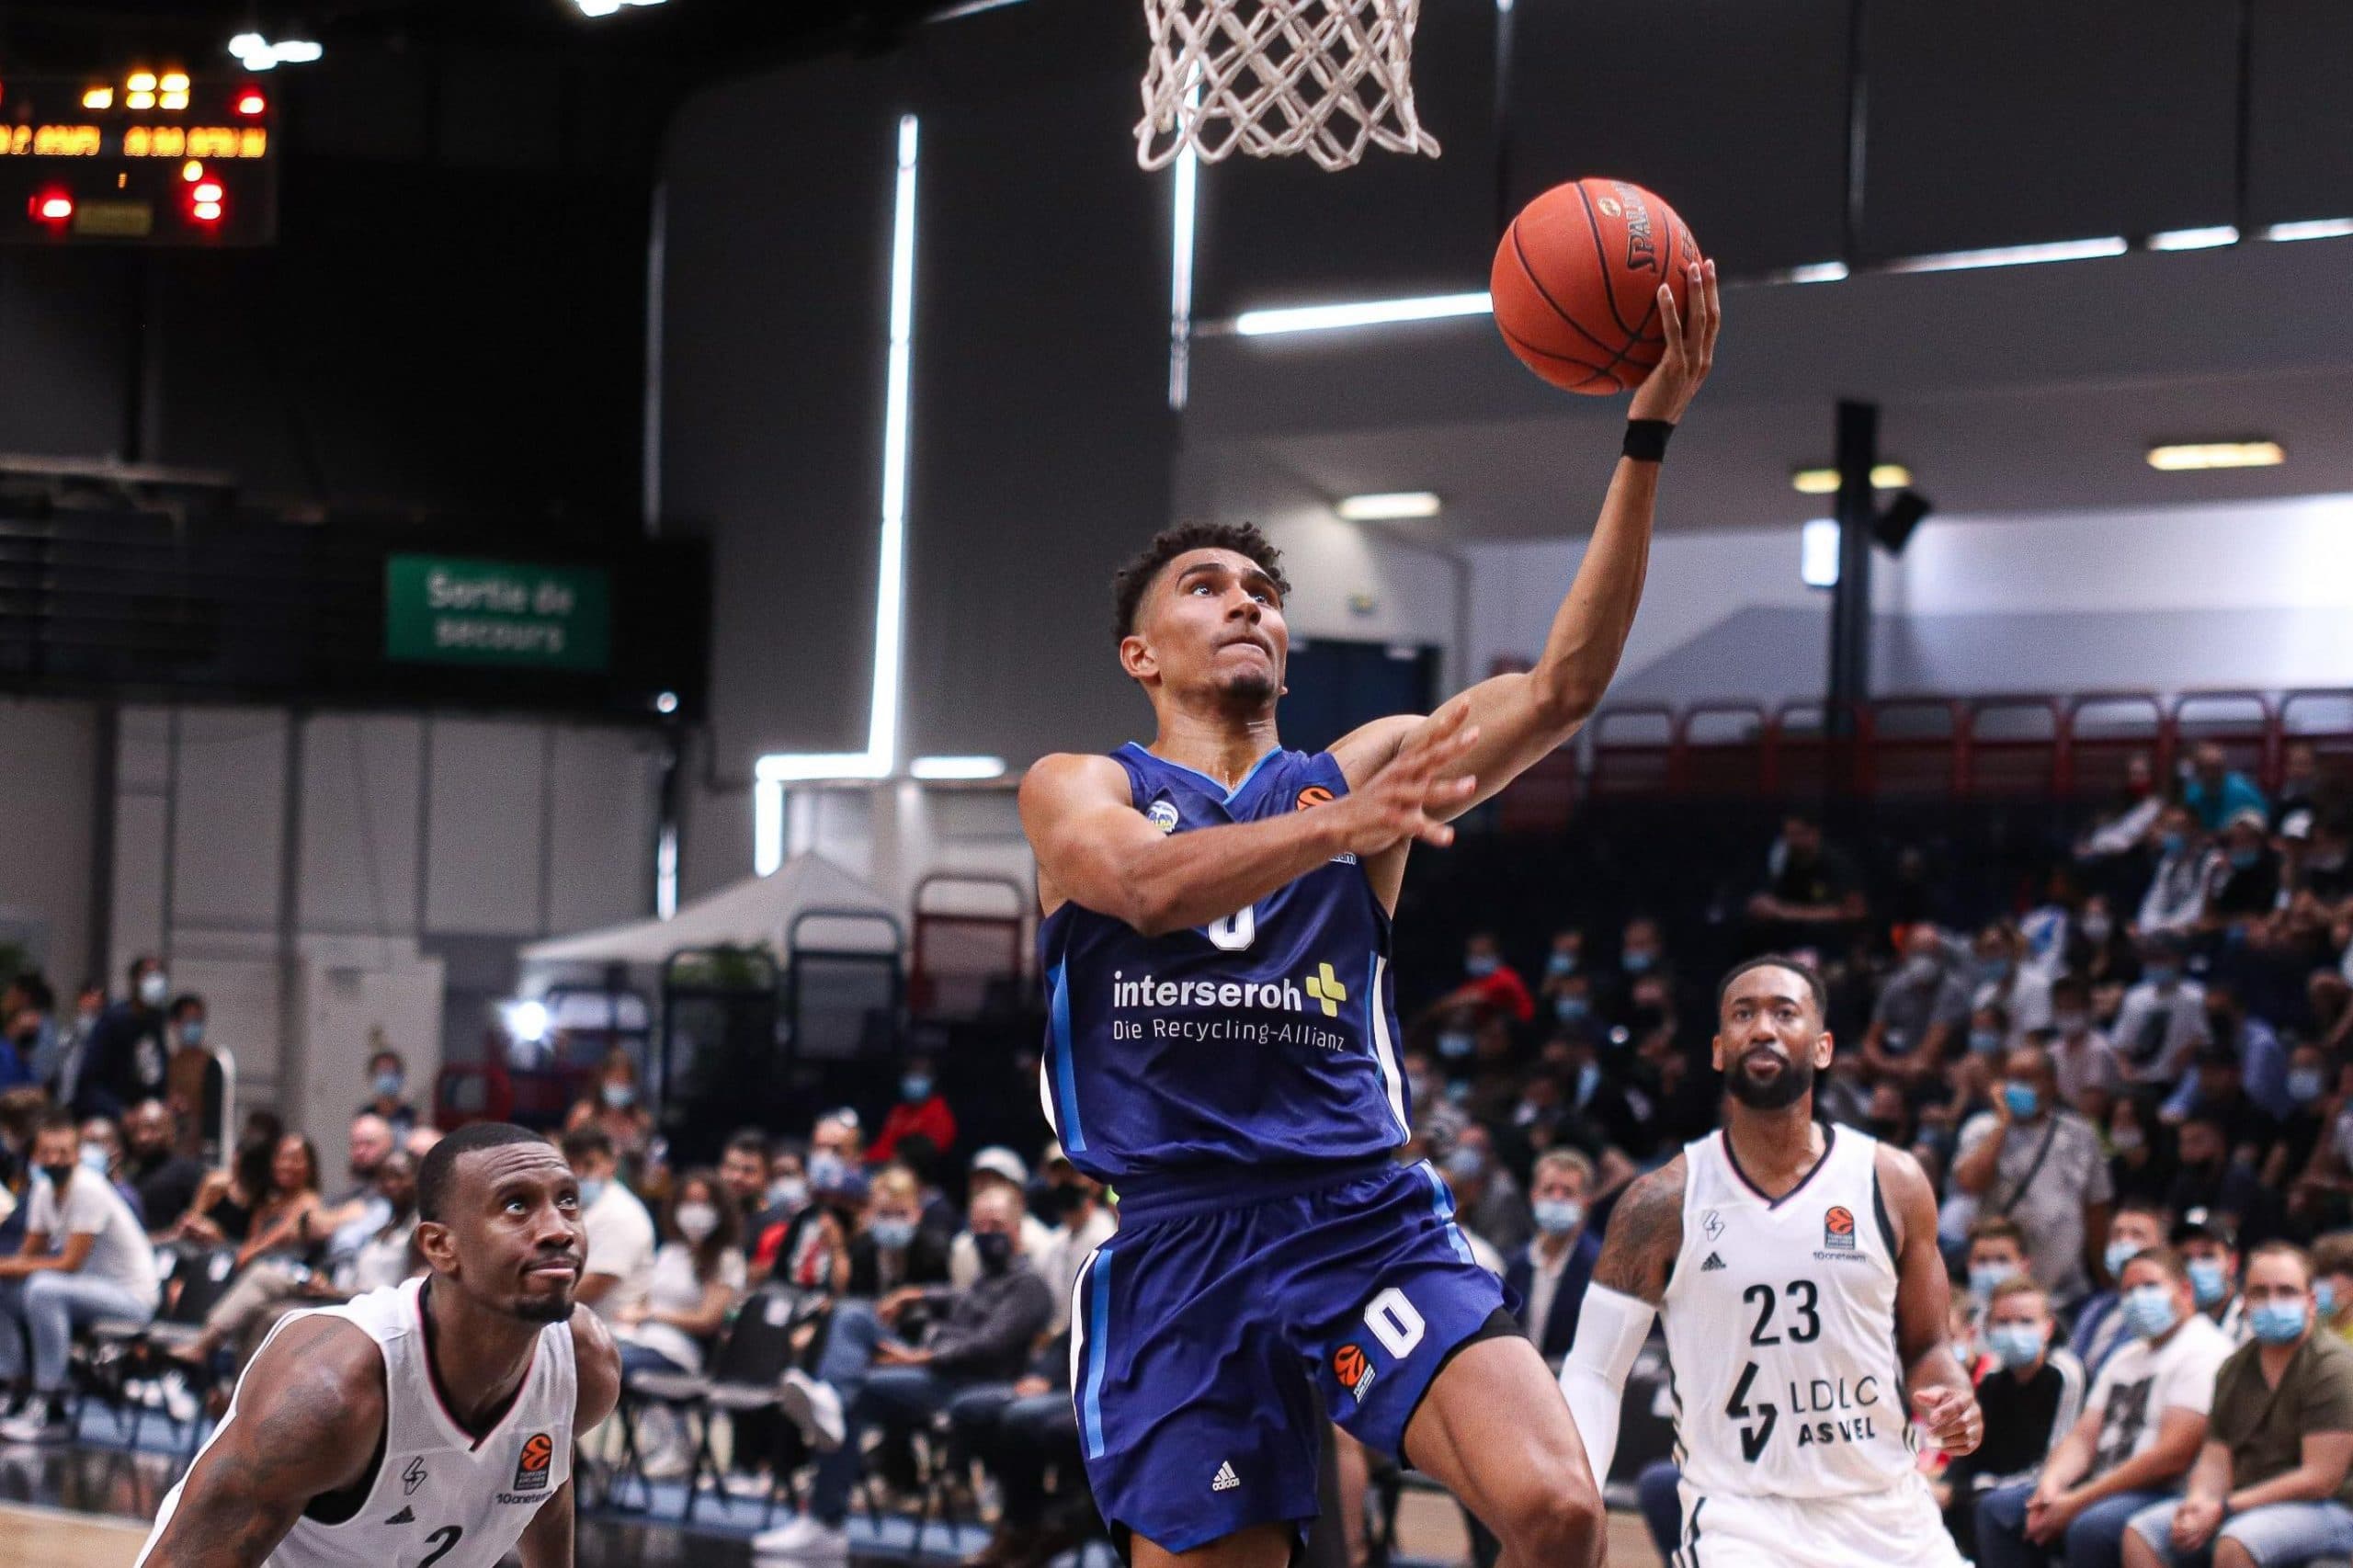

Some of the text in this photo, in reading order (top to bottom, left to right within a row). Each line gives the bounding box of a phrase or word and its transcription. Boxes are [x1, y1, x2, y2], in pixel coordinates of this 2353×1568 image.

[426, 572, 574, 617] Sortie de
[437, 619, 563, 653] secours
[1113, 970, 1302, 1012] interseroh
[1113, 1017, 1345, 1052] Die Recycling-Allianz
[1363, 1287, 1426, 1359] 0
[1742, 1279, 1821, 1347] 23
[1790, 1375, 1880, 1415] LDLC
[1797, 1416, 1876, 1449] ASVEL
[416, 1524, 463, 1568] 2
